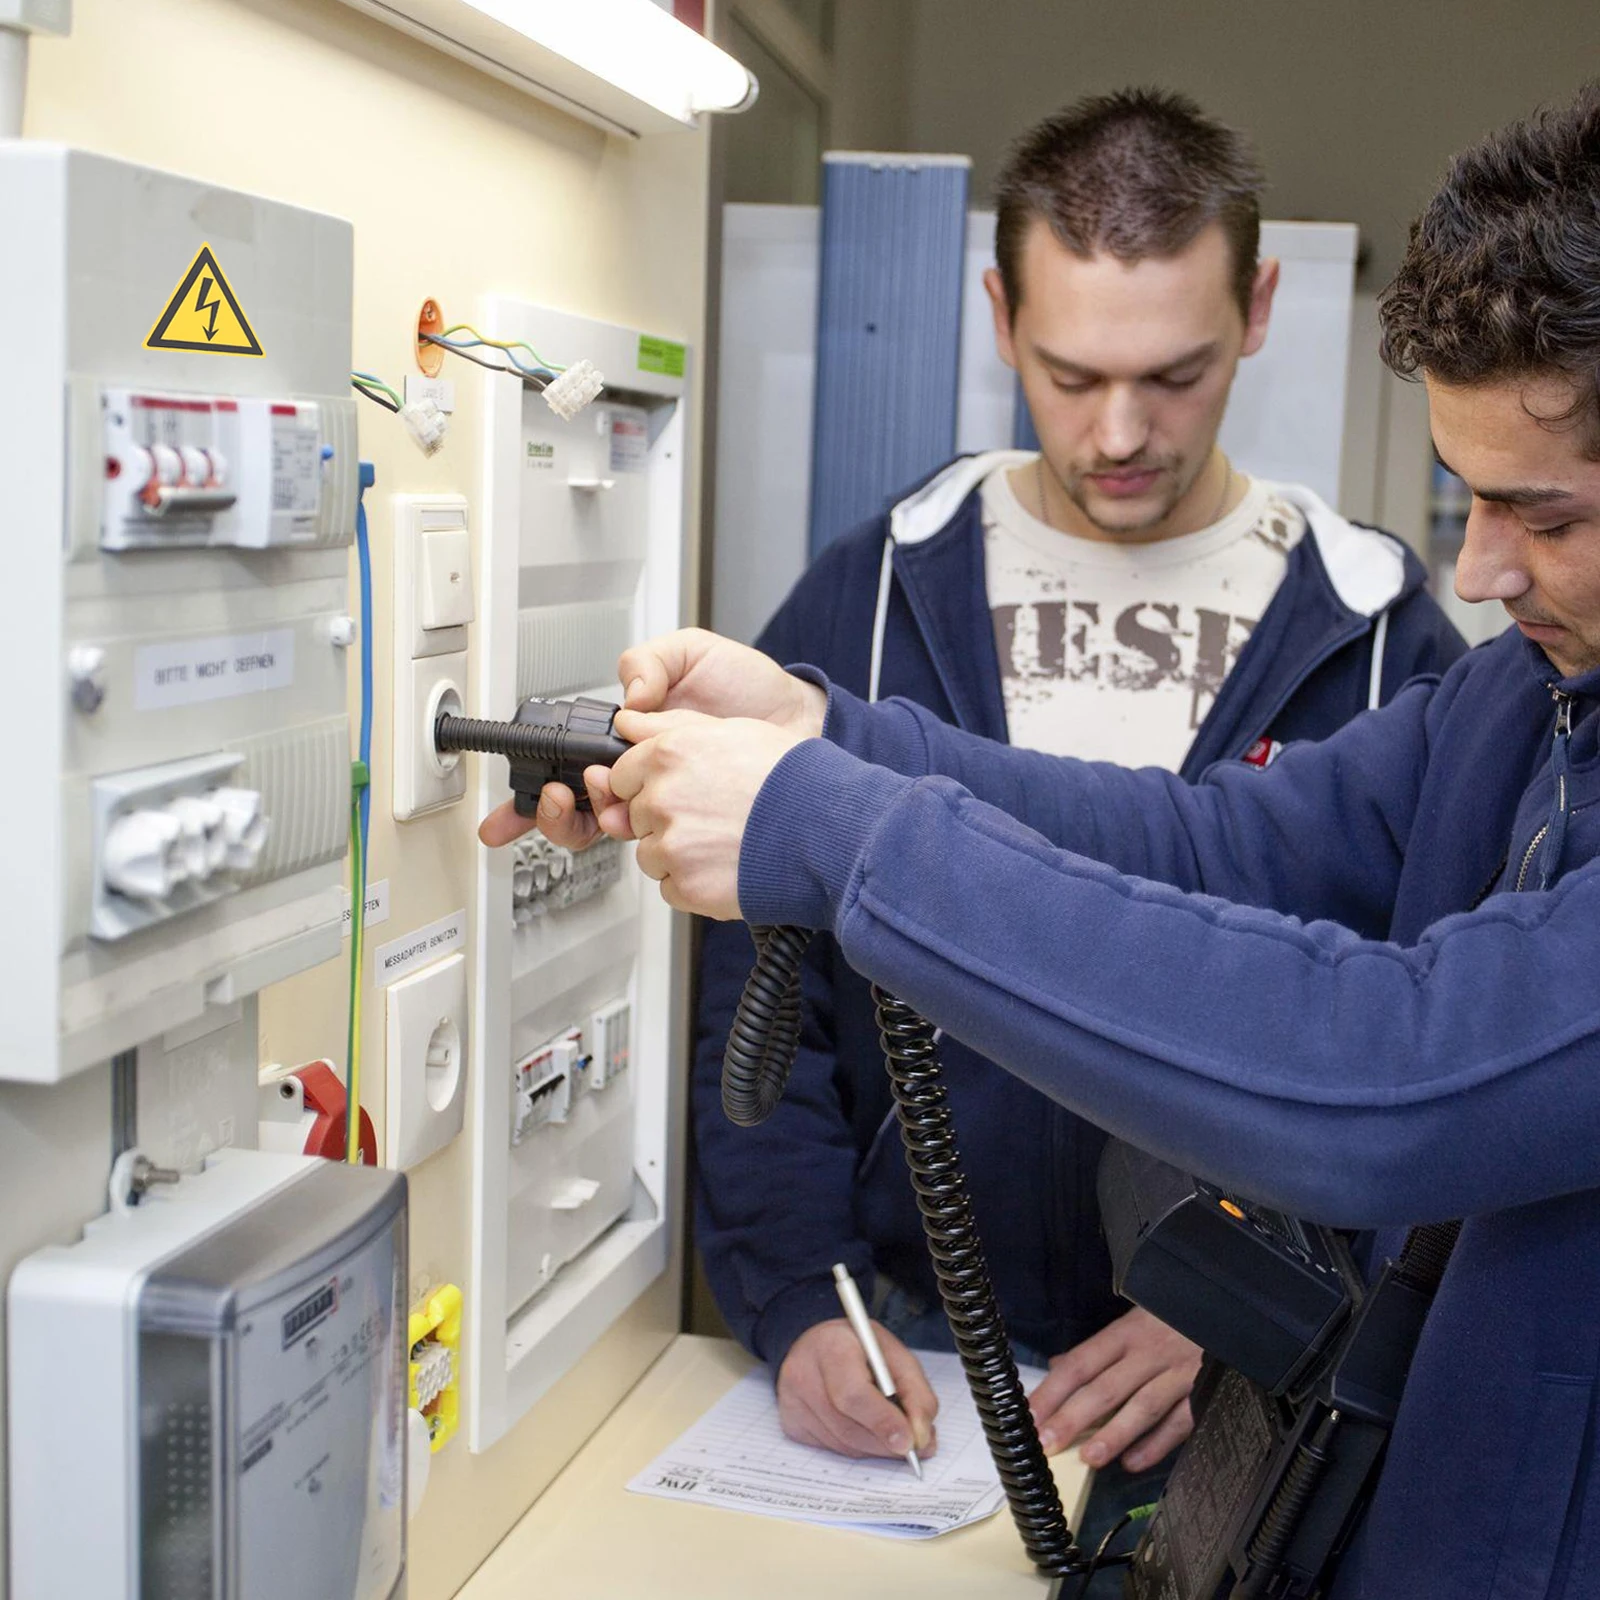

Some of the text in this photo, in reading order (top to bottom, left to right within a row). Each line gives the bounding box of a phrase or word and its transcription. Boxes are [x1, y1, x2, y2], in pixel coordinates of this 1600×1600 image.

[153, 664, 188, 685] BITTE
[196, 659, 227, 678] NICHT
[384, 927, 458, 969] MESSADAPTER BENUTZEN
[705, 1486, 841, 1513] ELEKTROTECHNIKER
